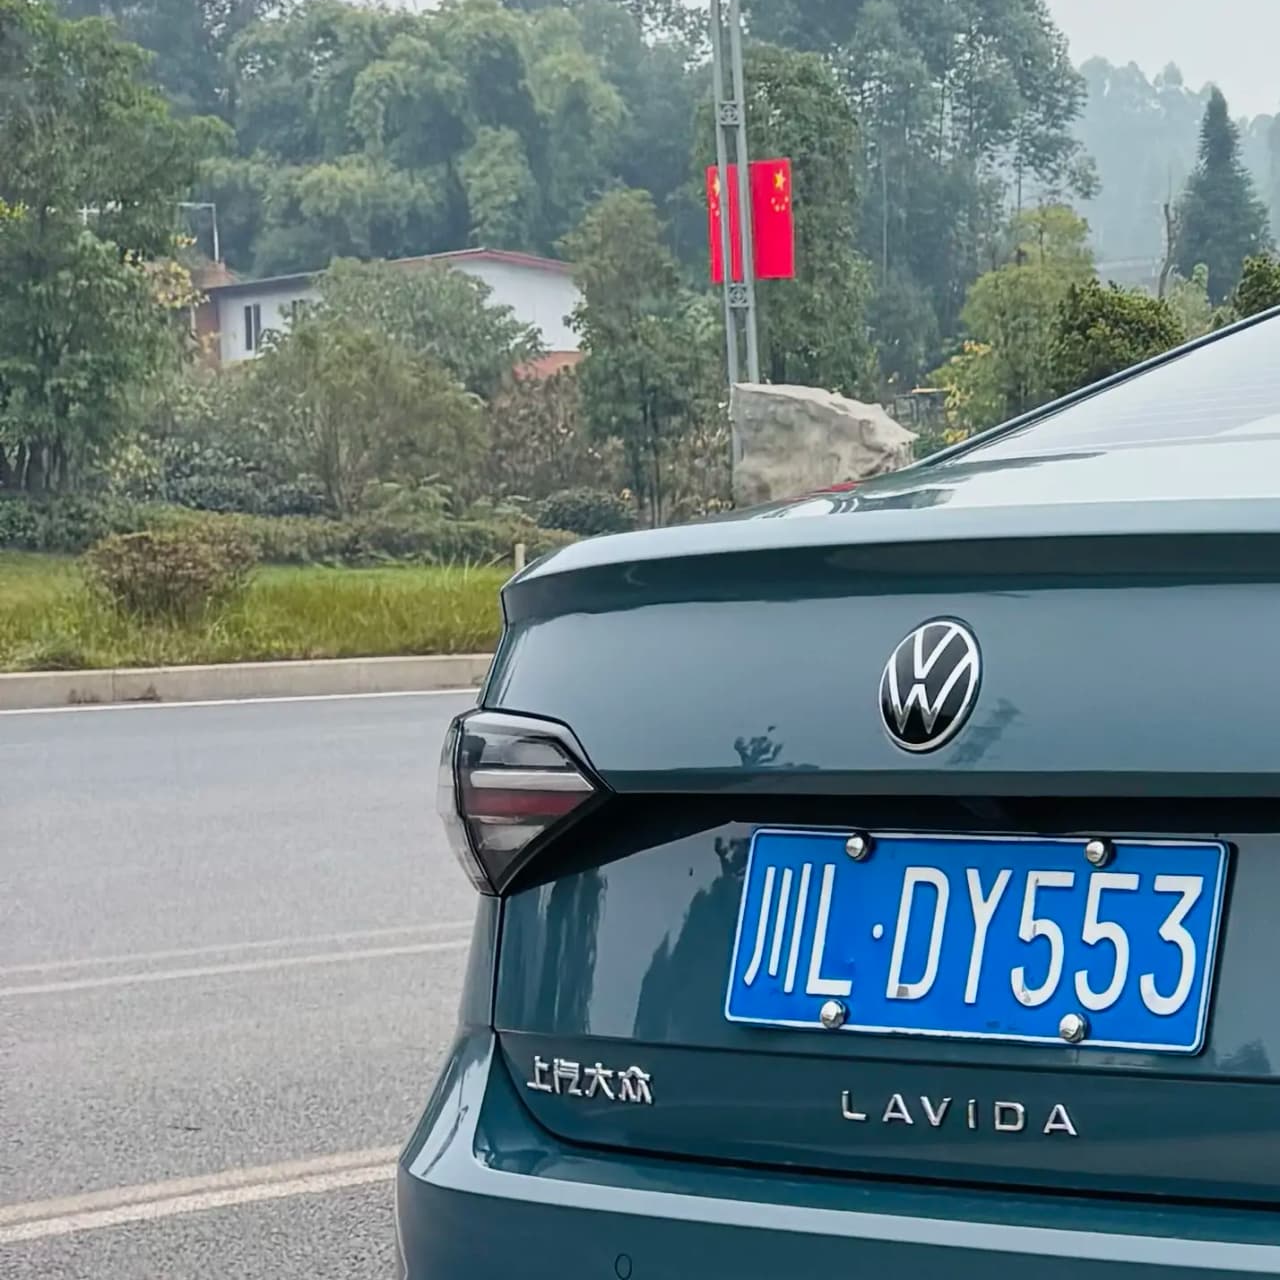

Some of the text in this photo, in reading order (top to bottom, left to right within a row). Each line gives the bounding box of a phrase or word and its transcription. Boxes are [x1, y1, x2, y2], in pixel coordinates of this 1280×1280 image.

[526, 1055, 652, 1104] 上汽大众
[840, 1089, 1078, 1136] LAVIDA
